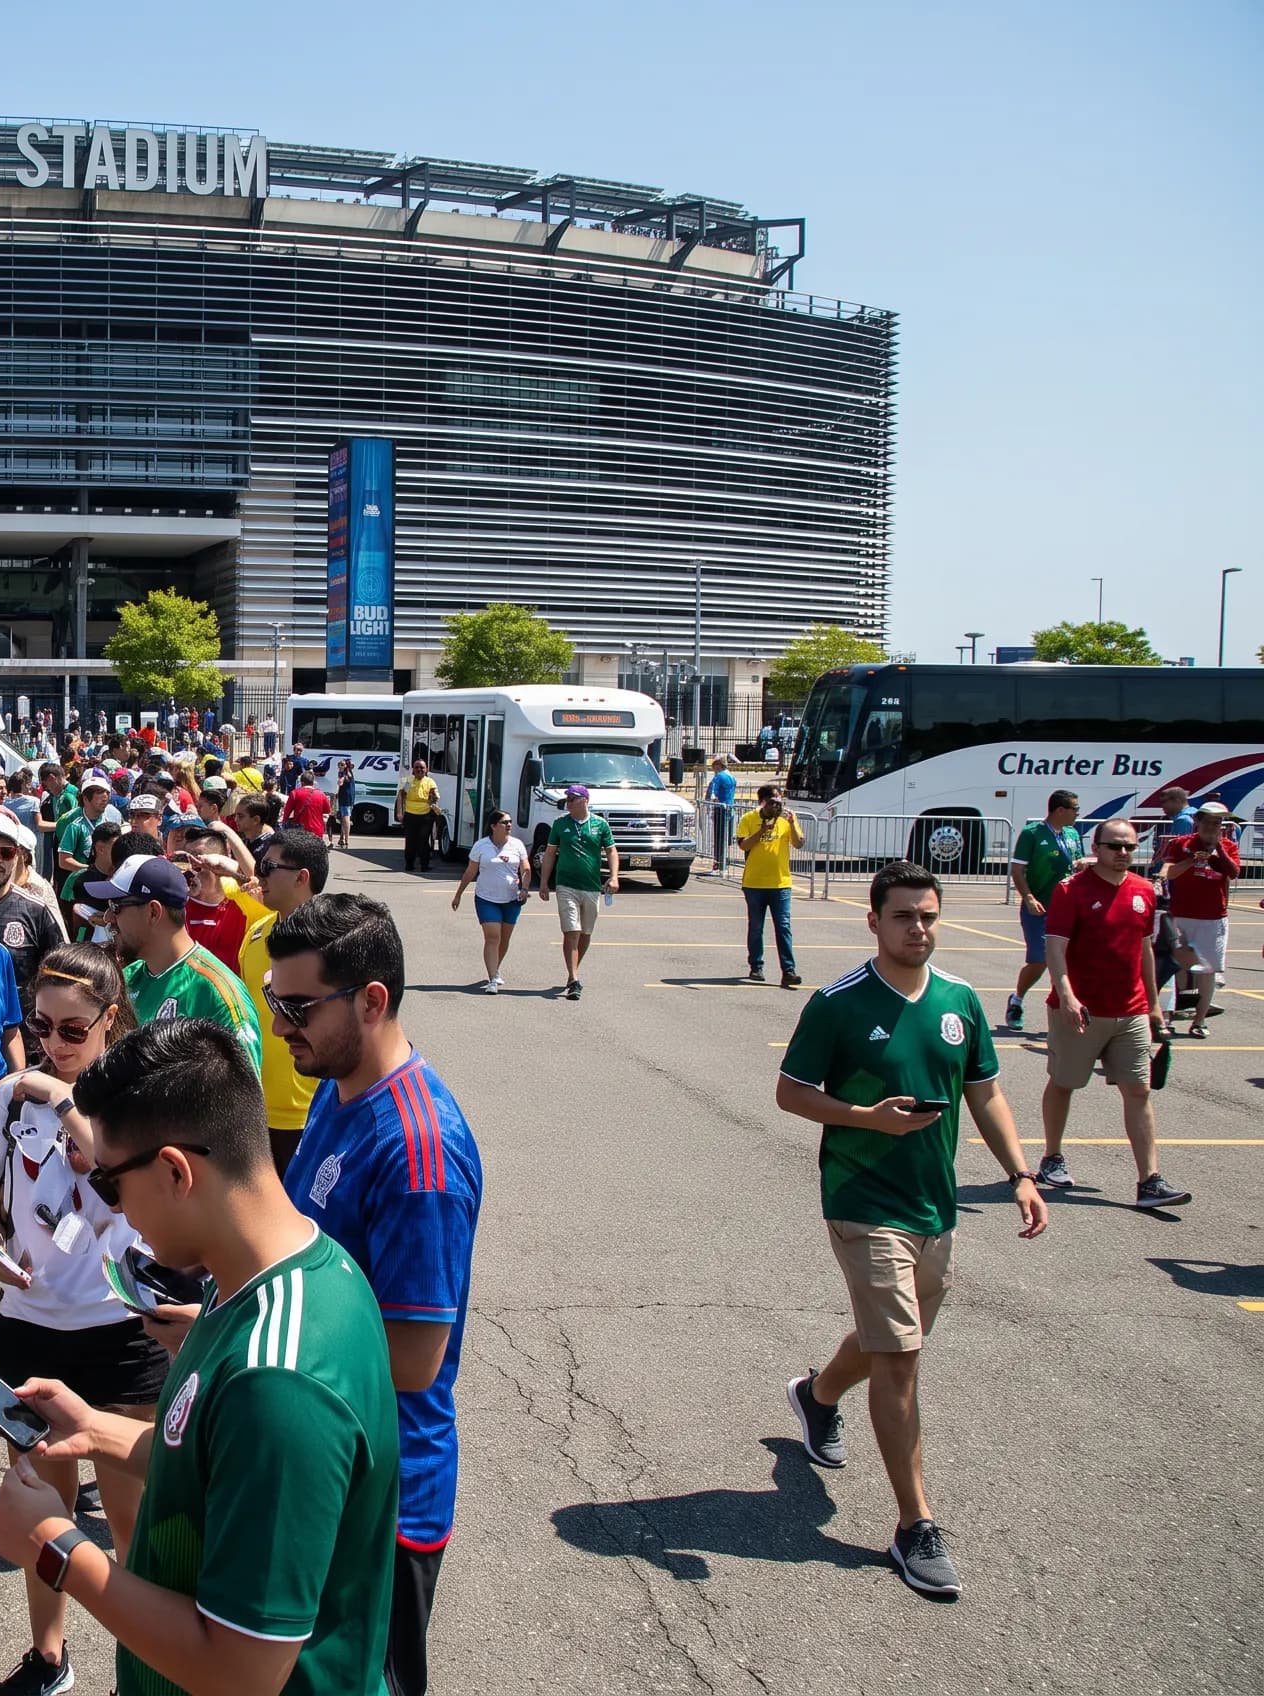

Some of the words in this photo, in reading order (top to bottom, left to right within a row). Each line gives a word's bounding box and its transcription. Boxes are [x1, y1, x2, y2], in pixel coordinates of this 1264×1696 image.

[15, 123, 267, 198] STADIUM
[354, 605, 388, 620] BUD
[350, 621, 390, 635] LIGHT
[998, 753, 1104, 776] Charter
[1112, 754, 1163, 776] Bus
